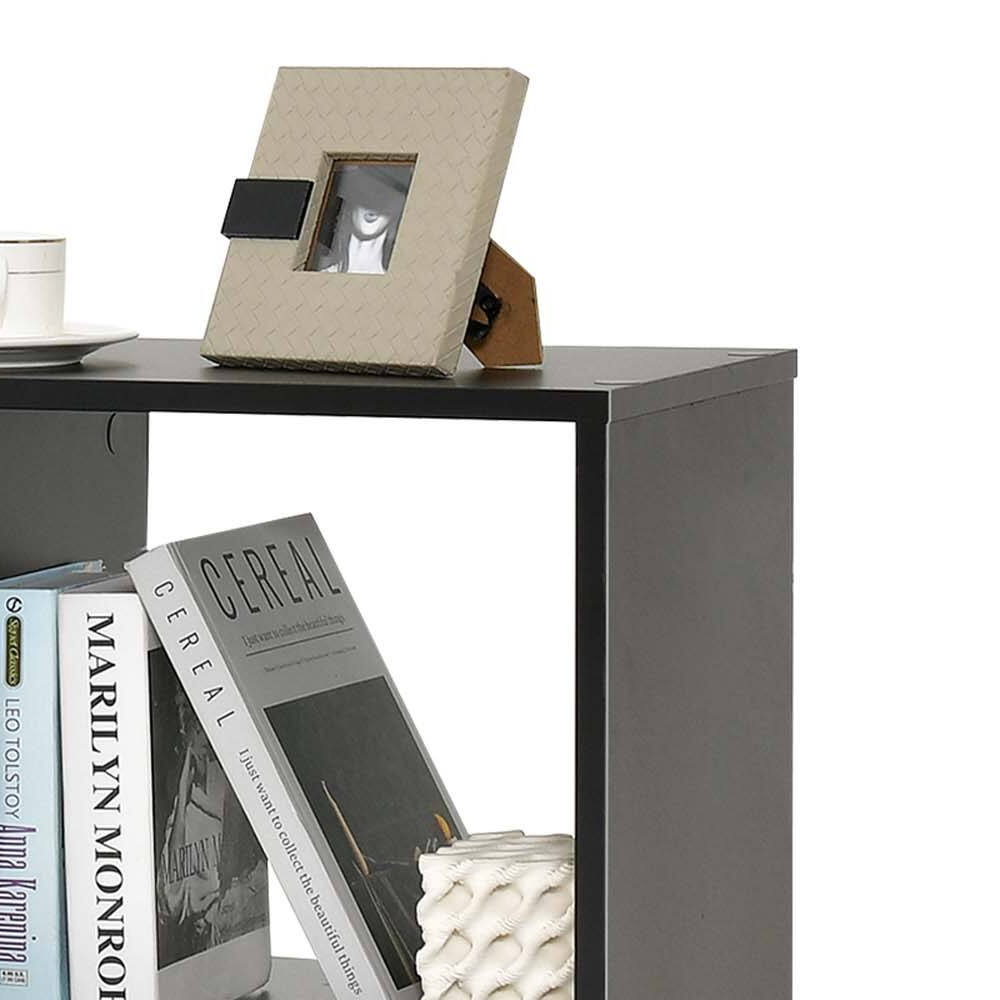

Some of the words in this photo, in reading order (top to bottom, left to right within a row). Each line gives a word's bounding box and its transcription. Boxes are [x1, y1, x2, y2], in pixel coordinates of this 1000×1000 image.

[200, 536, 342, 621] CEREAL
[86, 611, 121, 812] MARILYN
[153, 580, 235, 727] CEREAL
[5, 698, 20, 732] LEO
[5, 737, 20, 819] TOLSTOY
[241, 755, 260, 782] just
[256, 781, 275, 817] want
[272, 814, 283, 830] to
[279, 829, 304, 875] collect
[300, 868, 314, 895] the
[310, 893, 342, 953] beautiful
[338, 951, 362, 996] things
